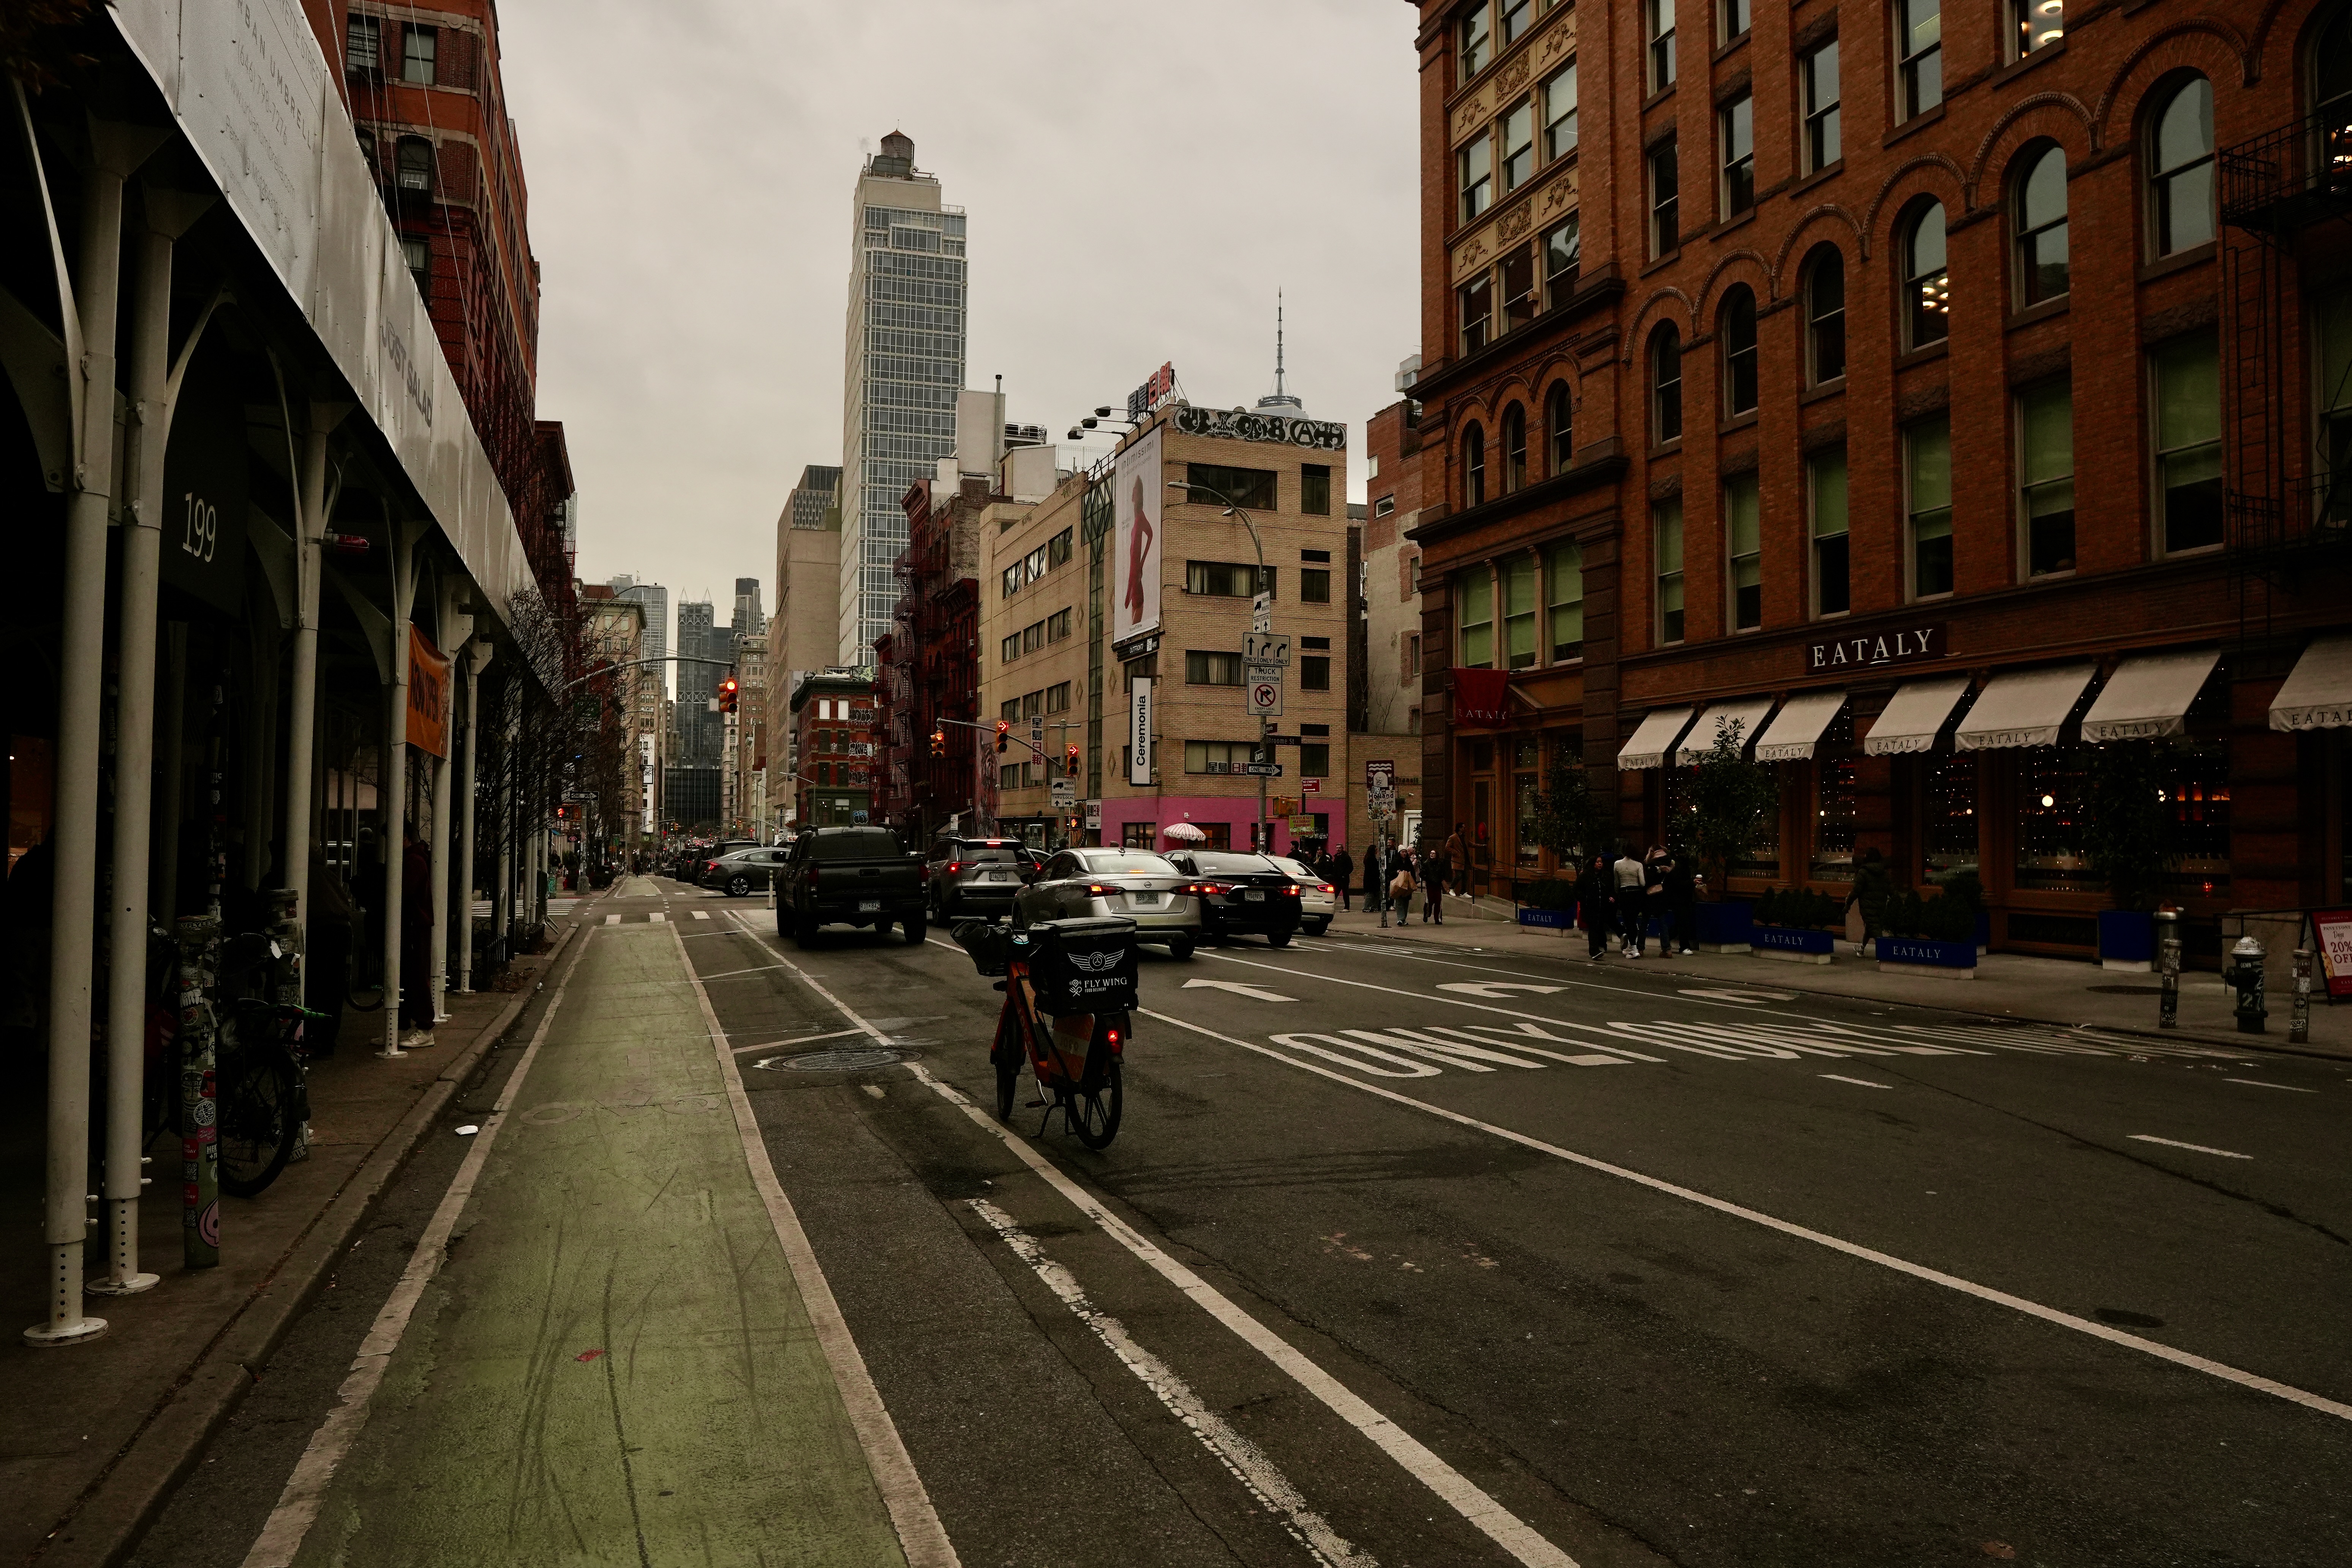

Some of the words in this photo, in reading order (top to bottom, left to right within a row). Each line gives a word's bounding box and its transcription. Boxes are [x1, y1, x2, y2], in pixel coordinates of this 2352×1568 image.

[407, 359, 433, 428] SALAD
[1122, 440, 1154, 470] intimissimi
[182, 492, 216, 562] 199
[1813, 629, 1934, 667] EATALY
[1136, 695, 1146, 766] Ceremonia
[1979, 733, 2031, 745] EATALY
[2101, 722, 2163, 737] EATALY
[1032, 718, 1042, 765] 星島日報
[1877, 740, 1920, 751] EATALY
[1625, 758, 1655, 767] EATALY
[1765, 748, 1804, 758] EATALY
[1765, 934, 1804, 945] EATALY
[1893, 946, 1941, 959] EATALY
[1084, 979, 1100, 988] FLY
[1102, 977, 1127, 986] WING
[1268, 1023, 1669, 1077] ONLY
[1606, 1021, 1997, 1060] ONLY
